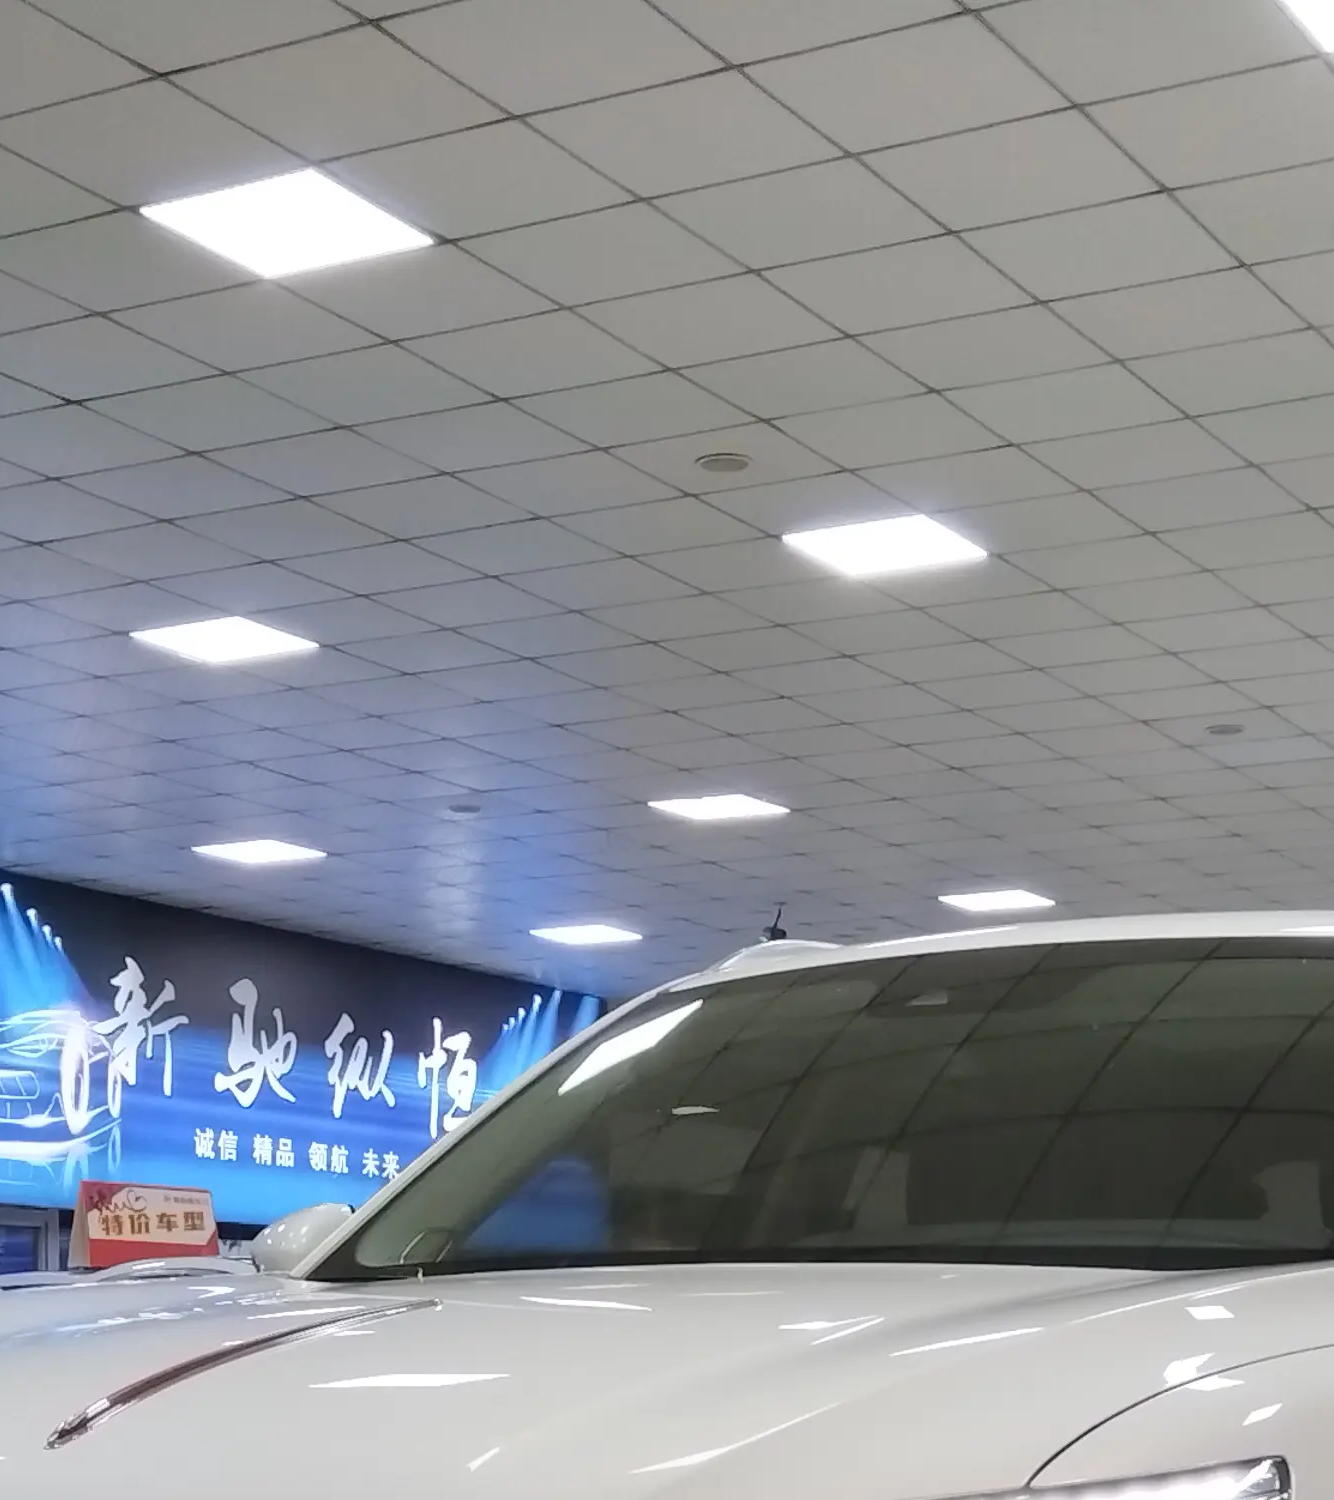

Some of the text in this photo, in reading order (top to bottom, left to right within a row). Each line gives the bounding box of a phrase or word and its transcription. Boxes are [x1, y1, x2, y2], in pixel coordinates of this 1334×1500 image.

[93, 956, 479, 1139] 新驰纵恒
[194, 1127, 401, 1180] 诚信 精品 领航 未来
[101, 1211, 205, 1236] 特价车型
